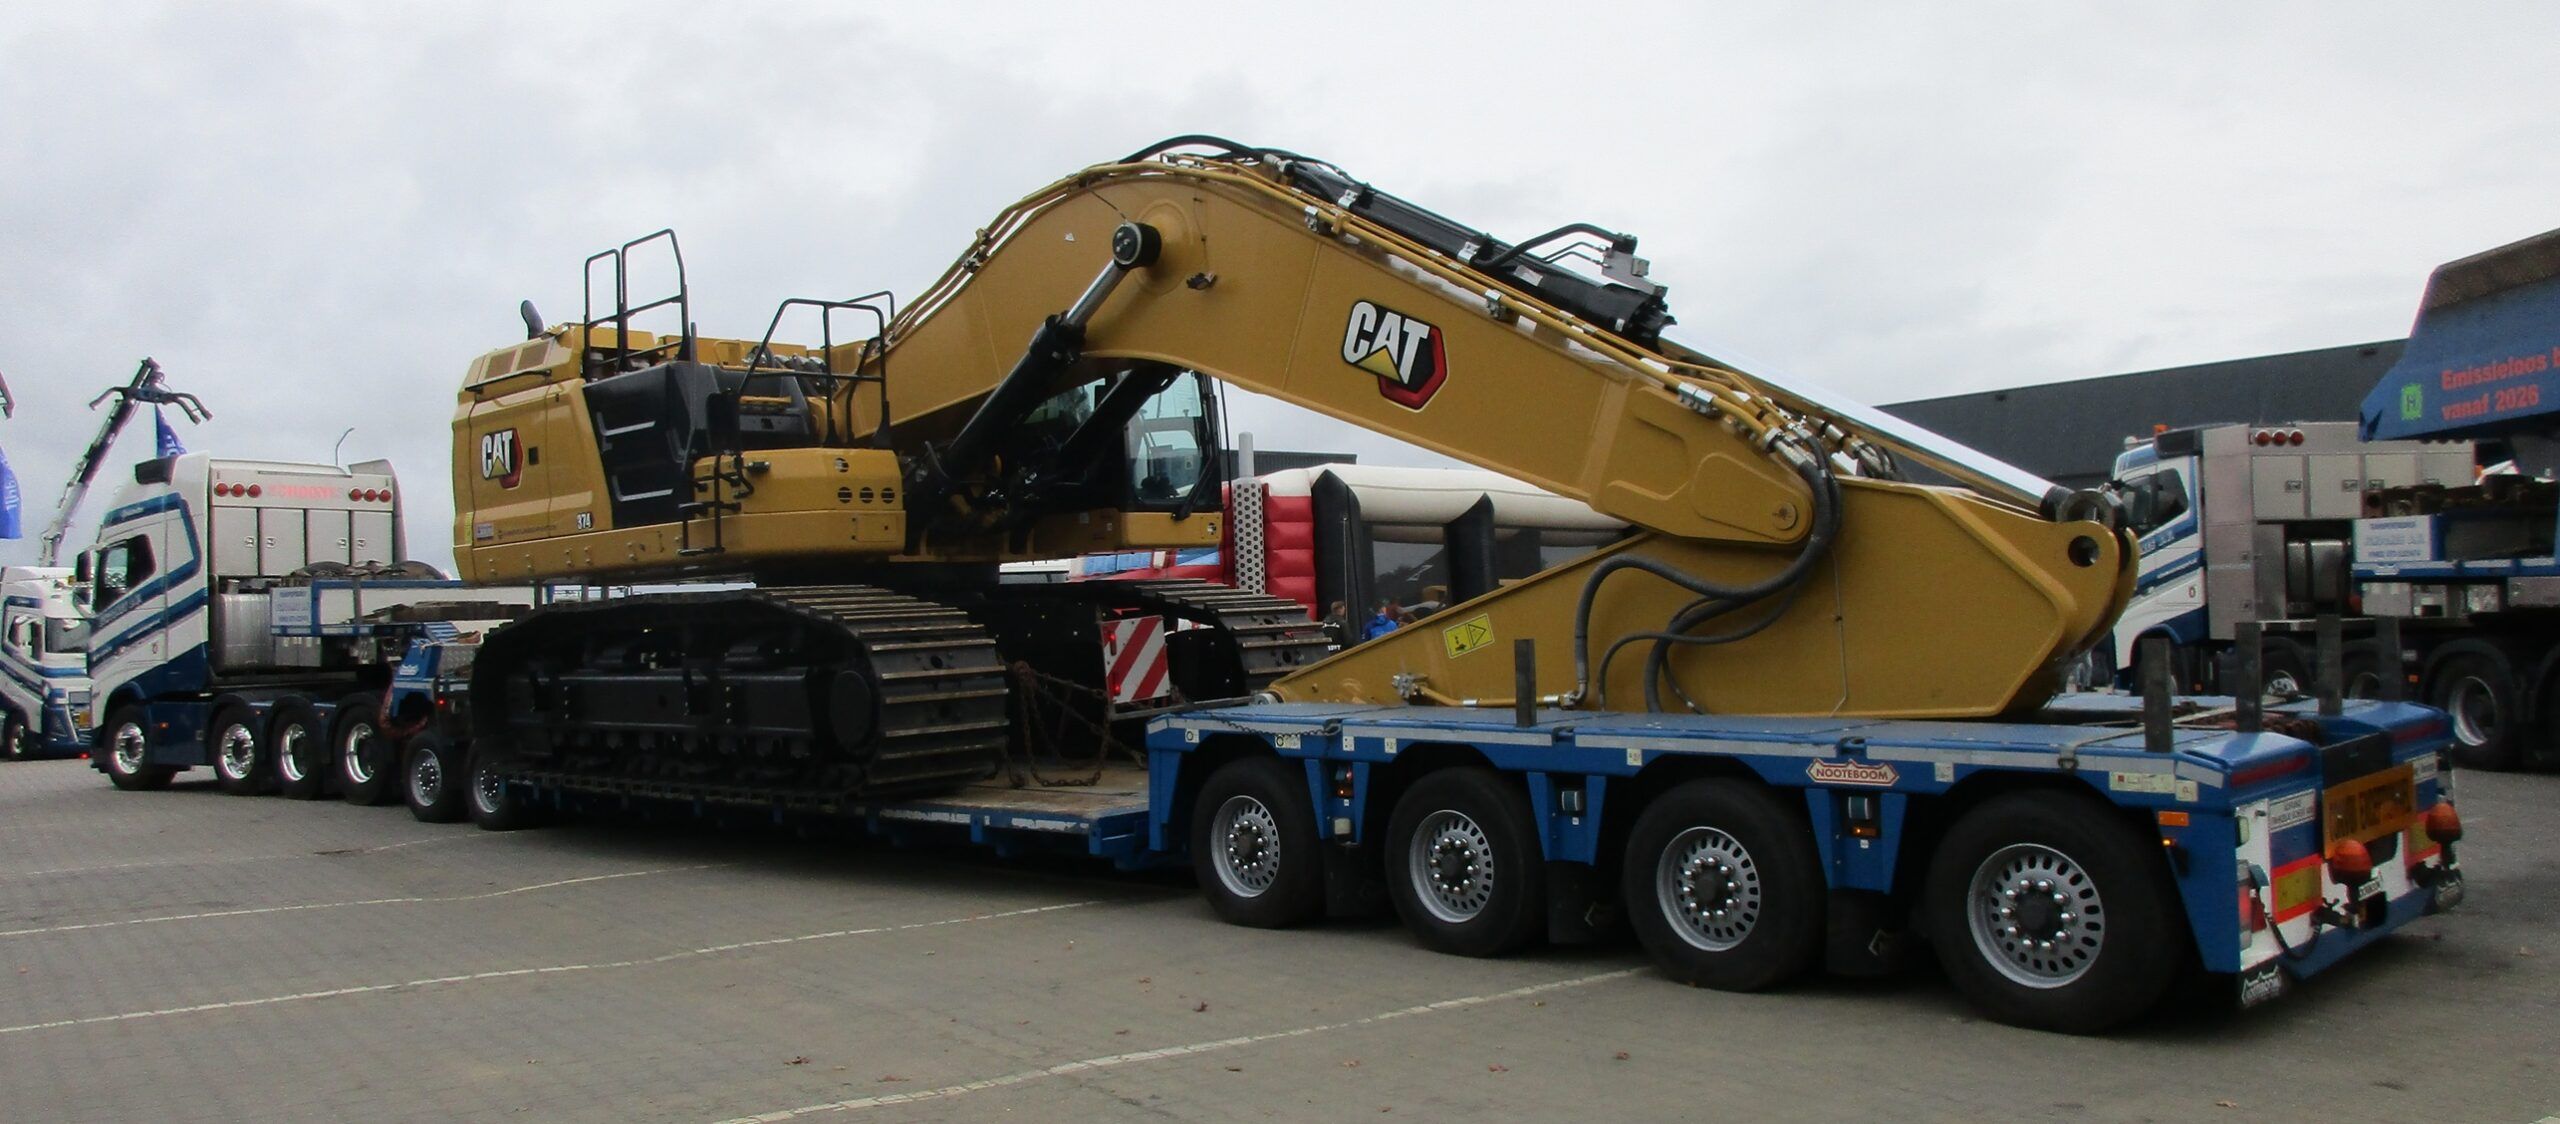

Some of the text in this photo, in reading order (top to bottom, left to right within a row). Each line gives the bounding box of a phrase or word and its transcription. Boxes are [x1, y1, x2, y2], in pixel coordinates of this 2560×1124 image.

[1343, 301, 1431, 385] CAT
[2442, 355, 2547, 389] Emissieloos
[2442, 393, 2489, 420] vanaf
[481, 430, 513, 478] CAT
[576, 513, 592, 530] 374
[1816, 769, 1888, 780] NOOTEBOOM
